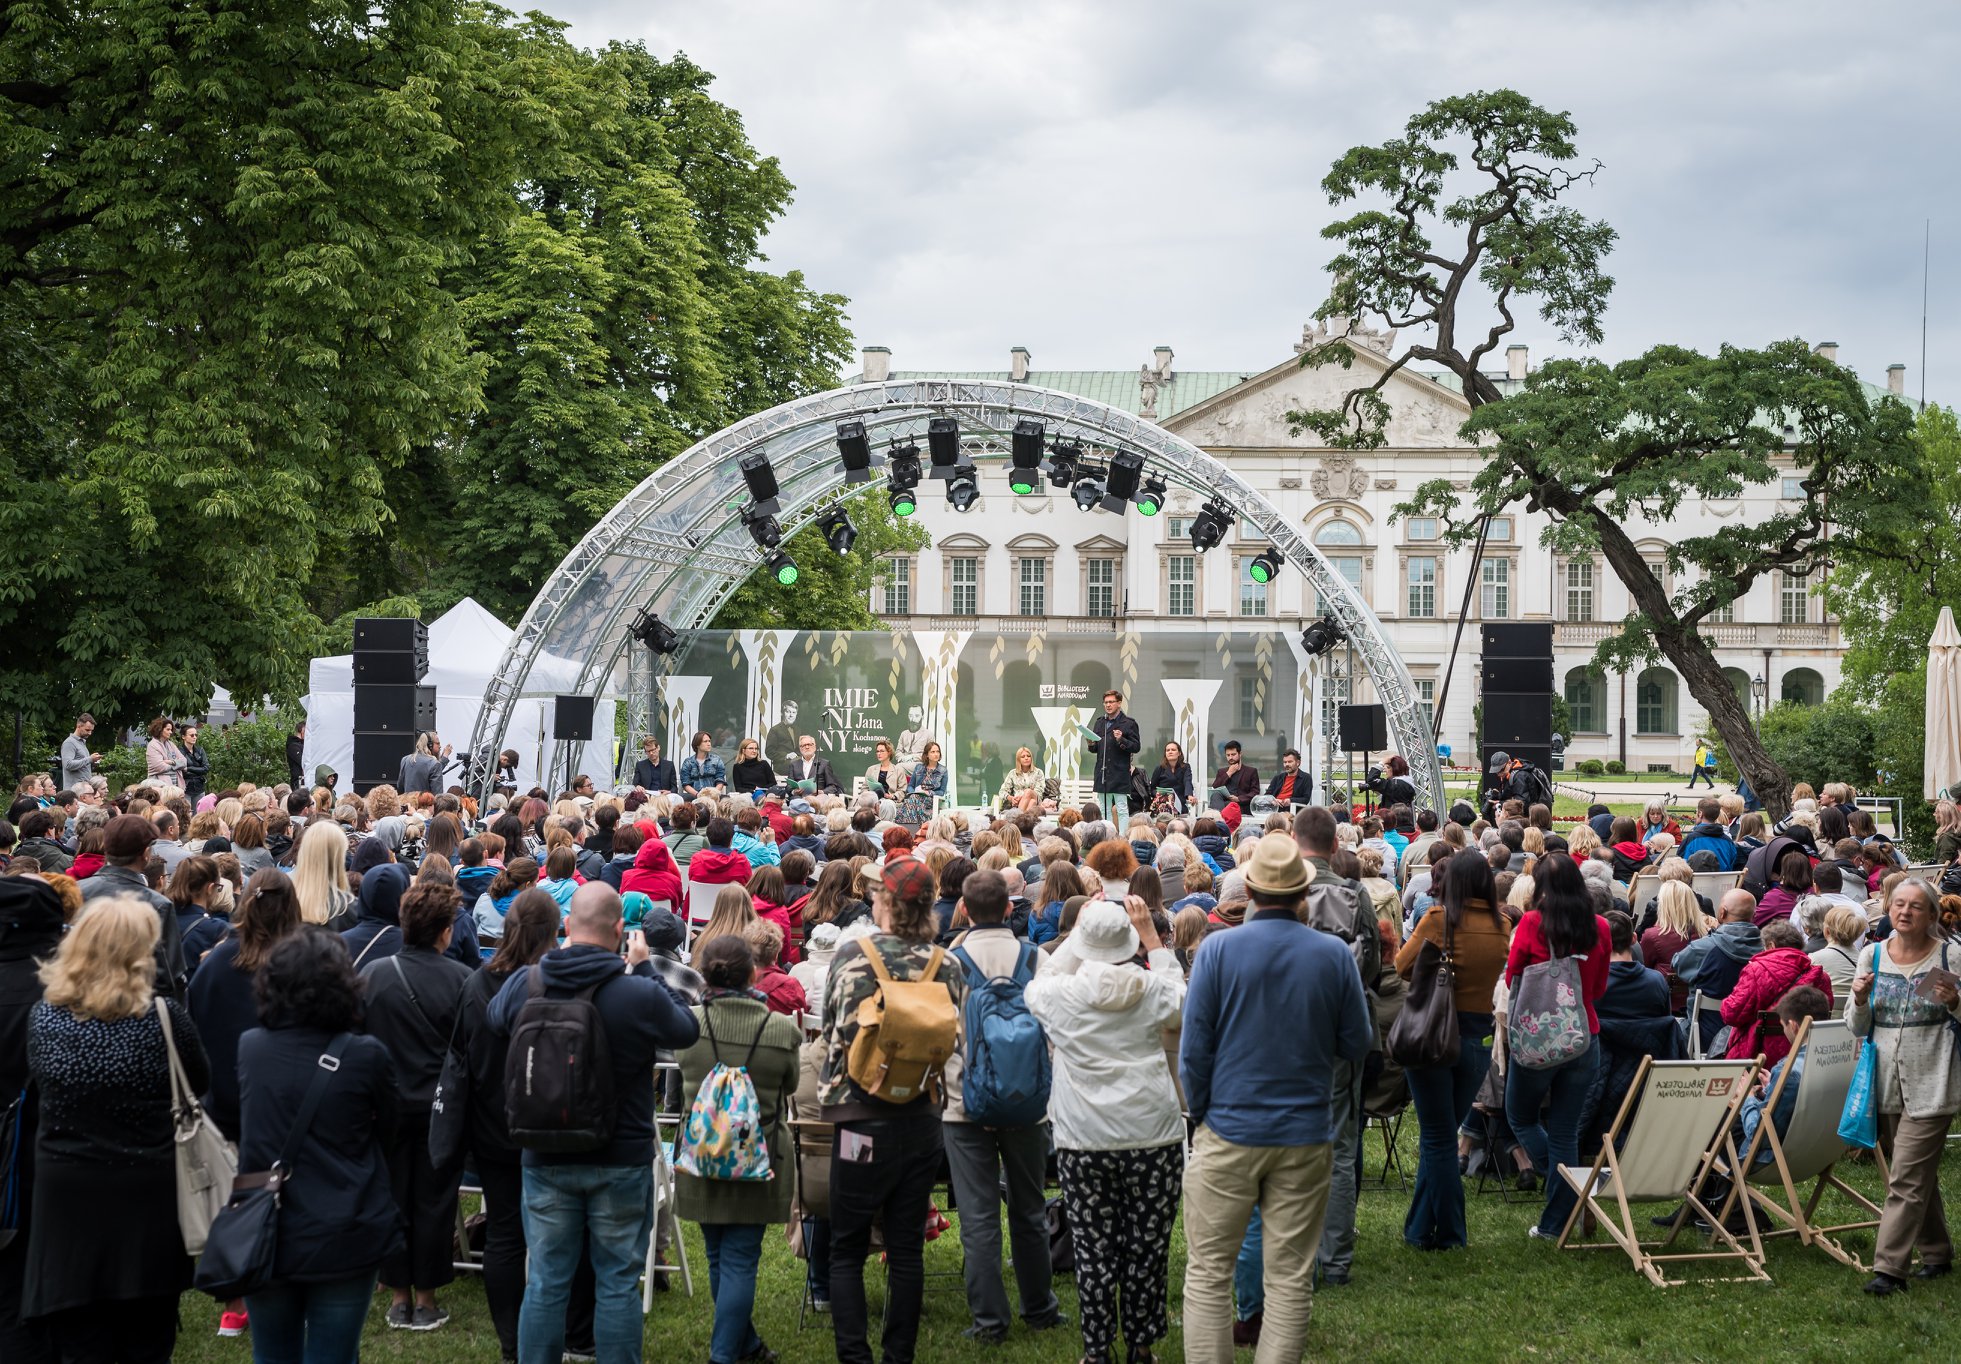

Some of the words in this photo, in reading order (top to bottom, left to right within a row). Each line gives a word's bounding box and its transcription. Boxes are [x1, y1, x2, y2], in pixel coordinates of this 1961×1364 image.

[1057, 684, 1090, 693] BIBLIOTEKA
[824, 688, 879, 708] IMIE
[828, 708, 853, 730] NI
[855, 712, 883, 729] Jana
[817, 729, 852, 753] NY
[852, 744, 873, 754] skiego
